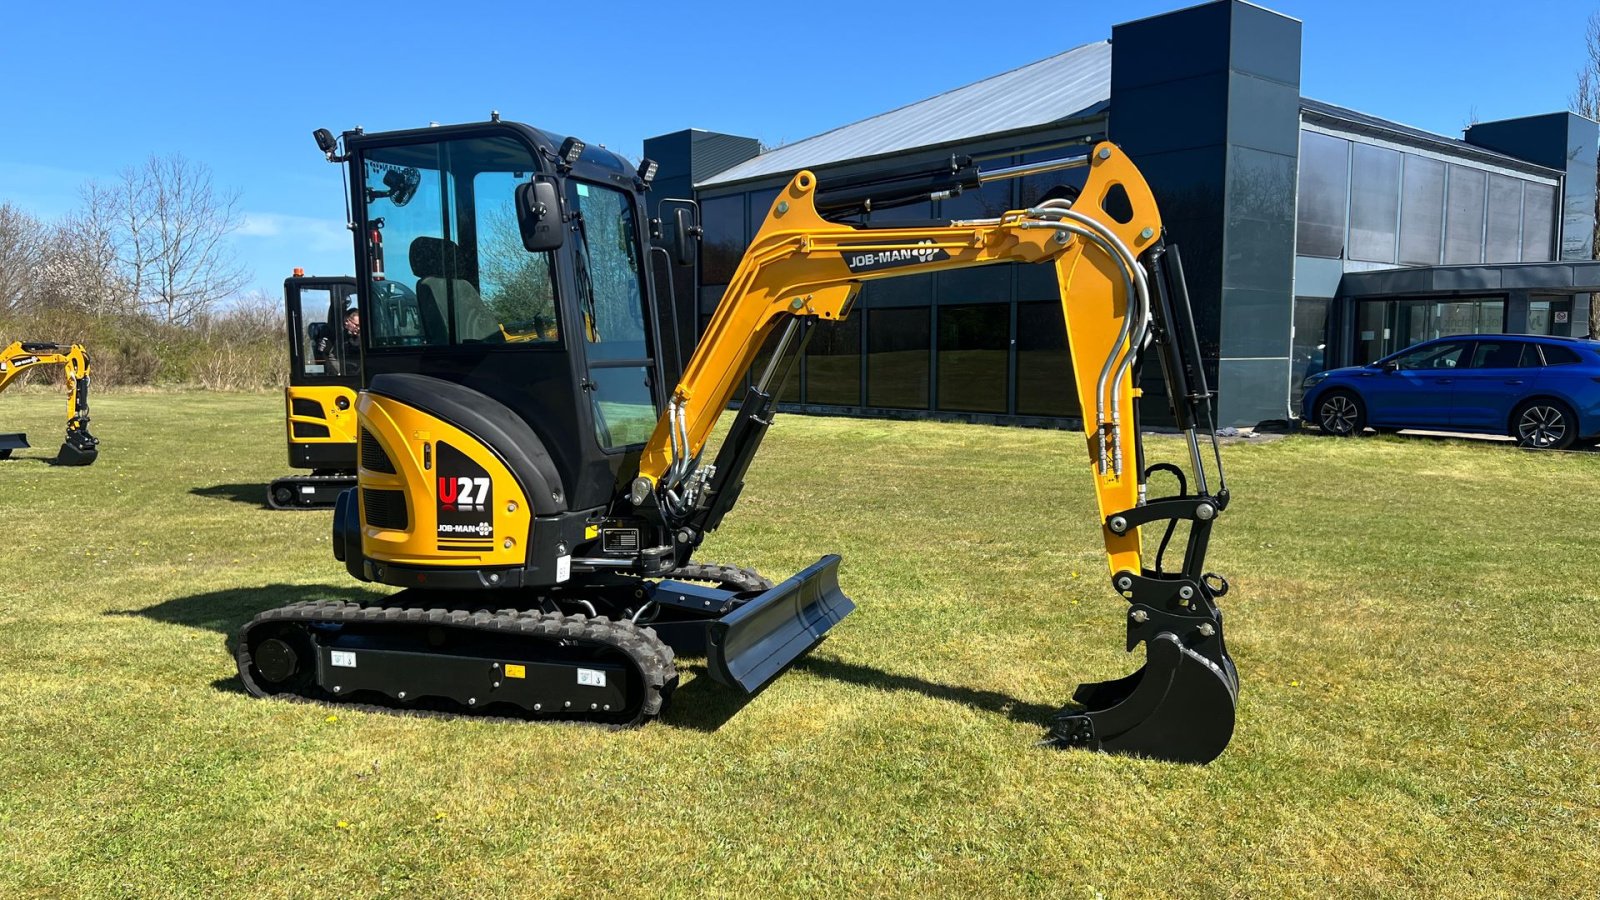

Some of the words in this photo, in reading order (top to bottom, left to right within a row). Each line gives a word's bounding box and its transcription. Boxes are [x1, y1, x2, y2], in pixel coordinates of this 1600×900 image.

[849, 249, 911, 267] JOB-MAN
[439, 477, 490, 504] U27
[438, 524, 475, 532] JOB-MAN
